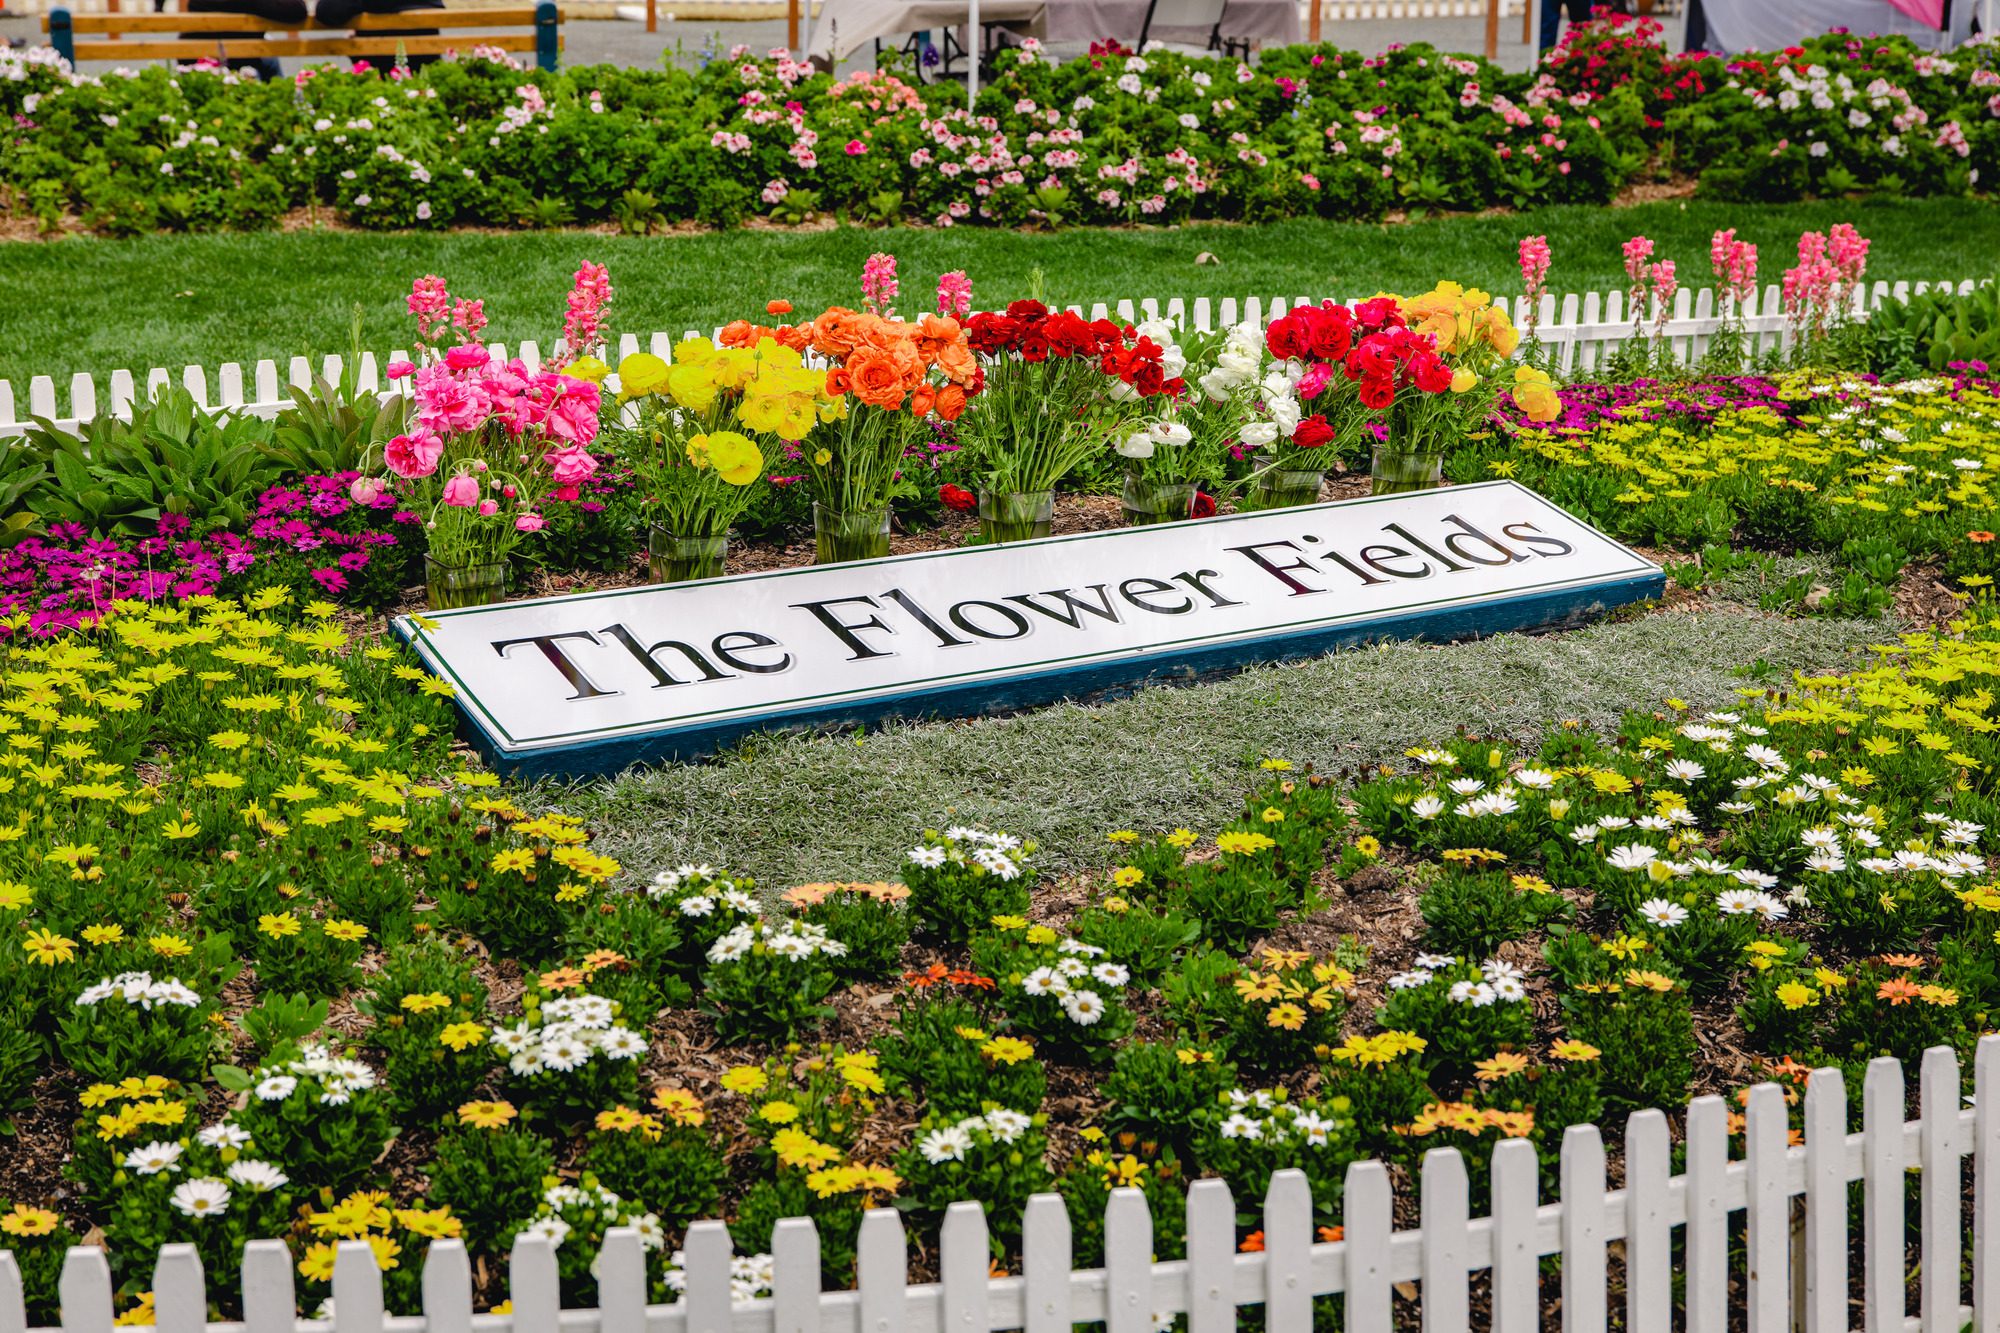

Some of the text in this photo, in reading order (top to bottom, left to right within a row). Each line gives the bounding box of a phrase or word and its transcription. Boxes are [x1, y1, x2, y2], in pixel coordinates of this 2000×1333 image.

[490, 514, 1572, 700] The Flower Fields
